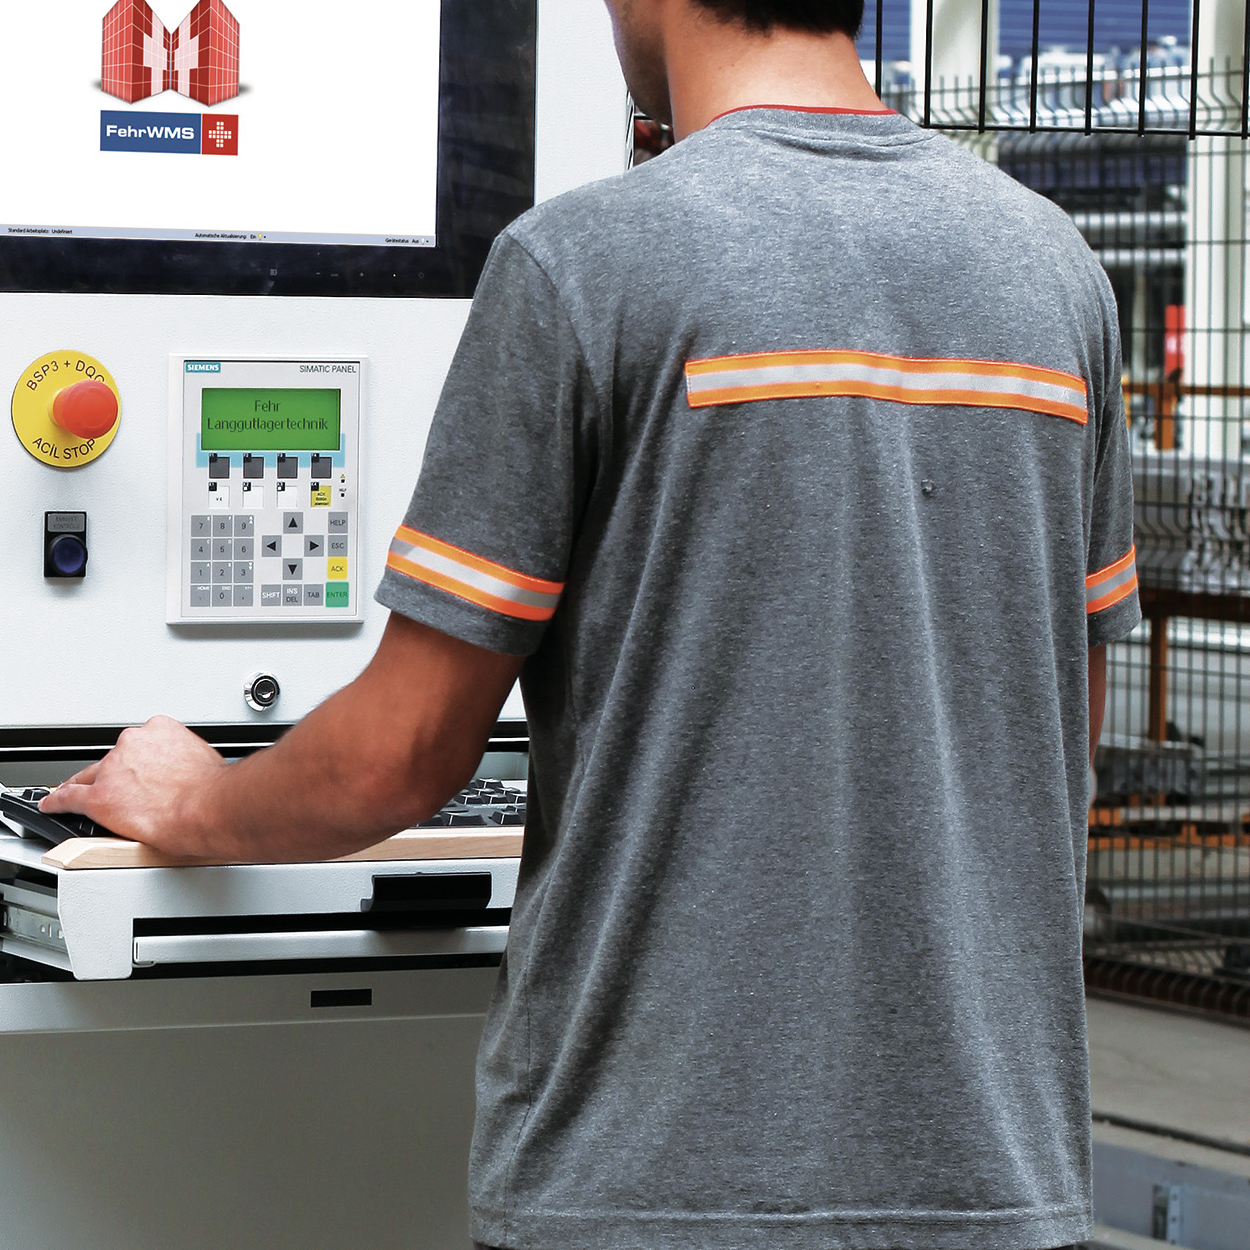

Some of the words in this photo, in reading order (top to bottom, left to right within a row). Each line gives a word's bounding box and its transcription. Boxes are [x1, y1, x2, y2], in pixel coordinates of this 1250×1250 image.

[106, 124, 195, 140] FehrWMS
[187, 363, 220, 372] SIEMENS
[299, 364, 331, 374] SIMATIC
[331, 364, 357, 374] PANEL
[26, 360, 59, 391] BSP3
[254, 399, 281, 413] Fehr
[207, 417, 329, 433] Langgutlagertechnik
[63, 438, 96, 460] STOP
[198, 522, 204, 530] 7
[220, 522, 226, 530] 8
[241, 522, 247, 530] 9
[198, 545, 204, 553] 4
[220, 545, 225, 553] 5
[241, 545, 247, 553] 6
[219, 568, 225, 576] 2
[240, 568, 246, 576] 3
[261, 591, 280, 599] SHIFT
[286, 587, 298, 595] INS
[219, 591, 225, 600] 0
